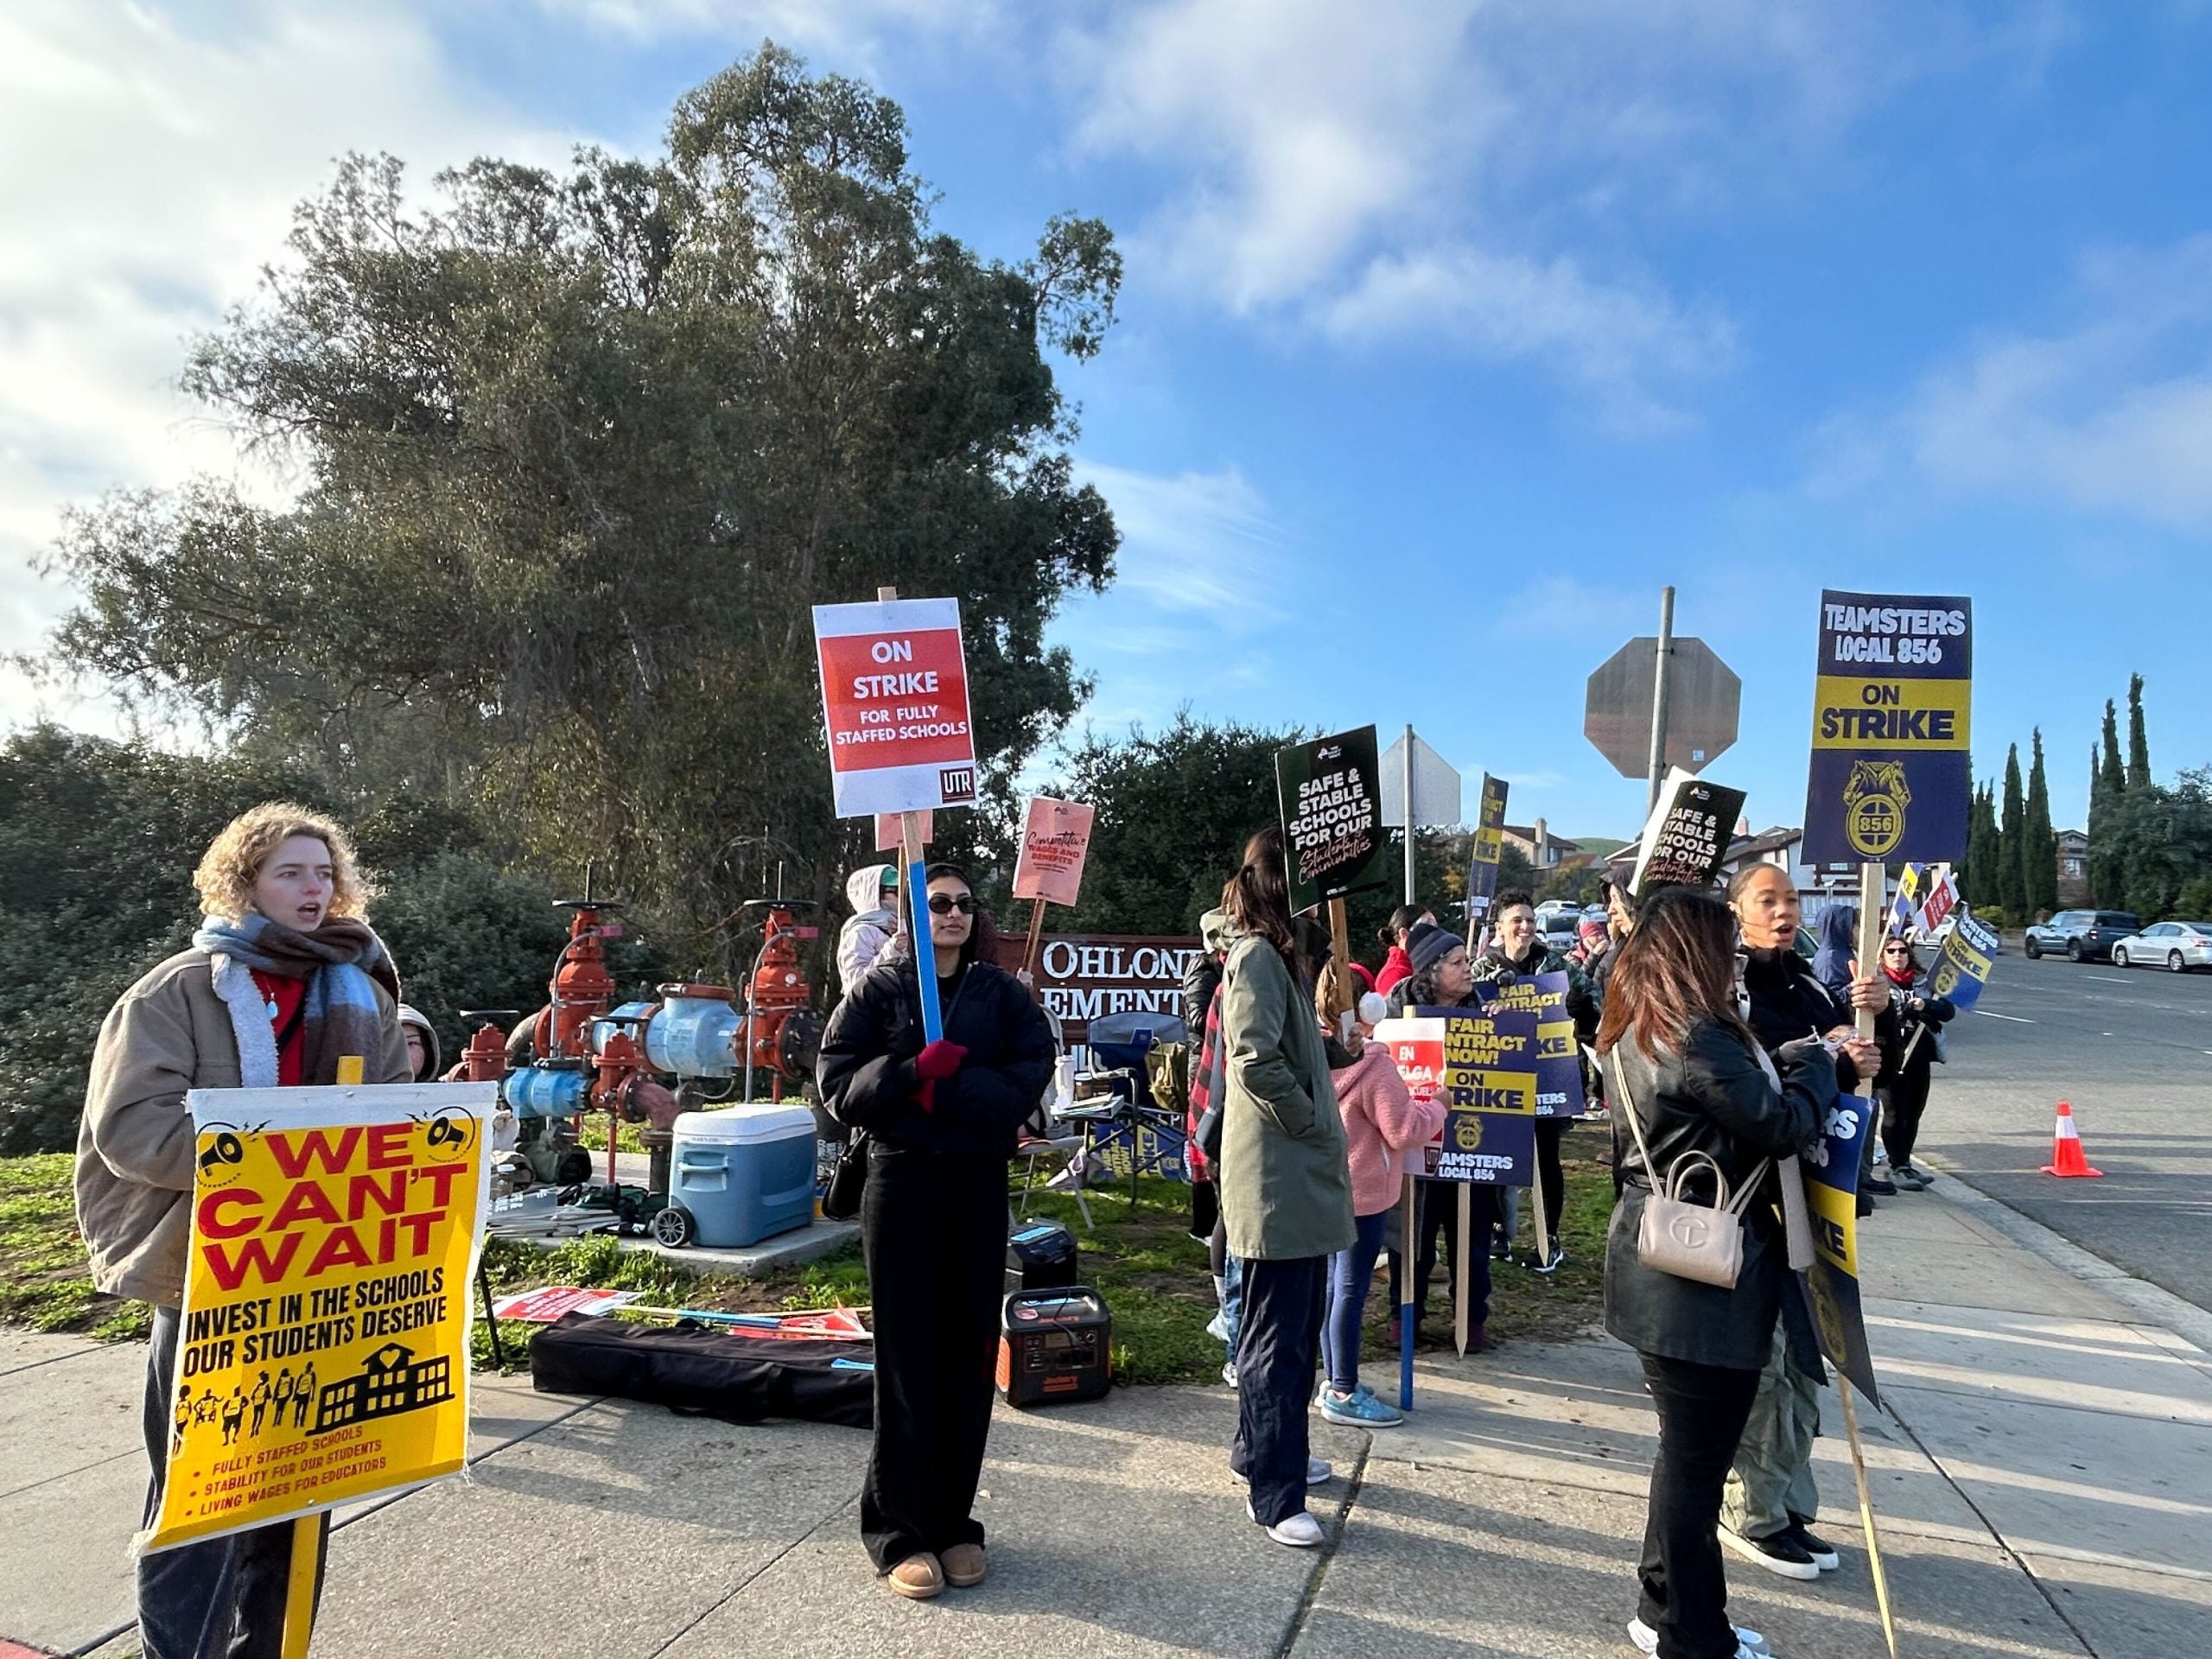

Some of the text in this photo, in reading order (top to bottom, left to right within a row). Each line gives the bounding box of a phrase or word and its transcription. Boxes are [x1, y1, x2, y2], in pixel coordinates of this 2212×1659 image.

[1825, 604, 1966, 636] TEAMSTERS
[872, 640, 912, 664] ON
[1834, 635, 1942, 664] LOCAL 856
[854, 671, 939, 699] STRIKE
[1862, 684, 1900, 705] ON
[860, 705, 939, 725] FOR FULLY
[1821, 707, 1955, 741] STRIKE
[836, 721, 967, 746] STAFFED SCHOOLS
[944, 771, 972, 793] UTR
[1299, 768, 1361, 798] SAFE &
[1298, 783, 1363, 817] STABLE
[1288, 798, 1372, 836] SCHOOLS
[1669, 807, 1717, 829] SAFE &
[1859, 817, 1892, 832] 856
[1294, 815, 1372, 851] FOR OUR
[1663, 821, 1716, 842] STABLE
[1028, 844, 1080, 858] WAGES AND
[1031, 853, 1073, 865] BENEFITS
[1675, 849, 1713, 869] OUR
[1043, 941, 1205, 979] OHLON
[1499, 983, 1536, 998] FAIR
[1449, 1018, 1495, 1034] FAIR
[1398, 1046, 1415, 1061] EN
[1446, 1049, 1500, 1065] NOW!
[1456, 1071, 1484, 1086] ON
[1448, 1086, 1524, 1109] RIKE
[264, 1123, 414, 1179] WE
[1439, 1152, 1514, 1170] AMSTERS
[1439, 1166, 1496, 1180] LOCAL 856
[198, 1162, 467, 1239] CAN'T
[201, 1211, 446, 1292] WAIT
[186, 1267, 444, 1344] INVEST IN THE SCHOOLS
[184, 1296, 447, 1378] OUR STUDENTS DESERVE
[213, 1426, 363, 1475] FULLY STAFFED SCHOOLS
[205, 1440, 382, 1496] STABILITY FOR OUR STUDENTS
[200, 1457, 387, 1516] LIVING WAGES FOR EDUCATORS
